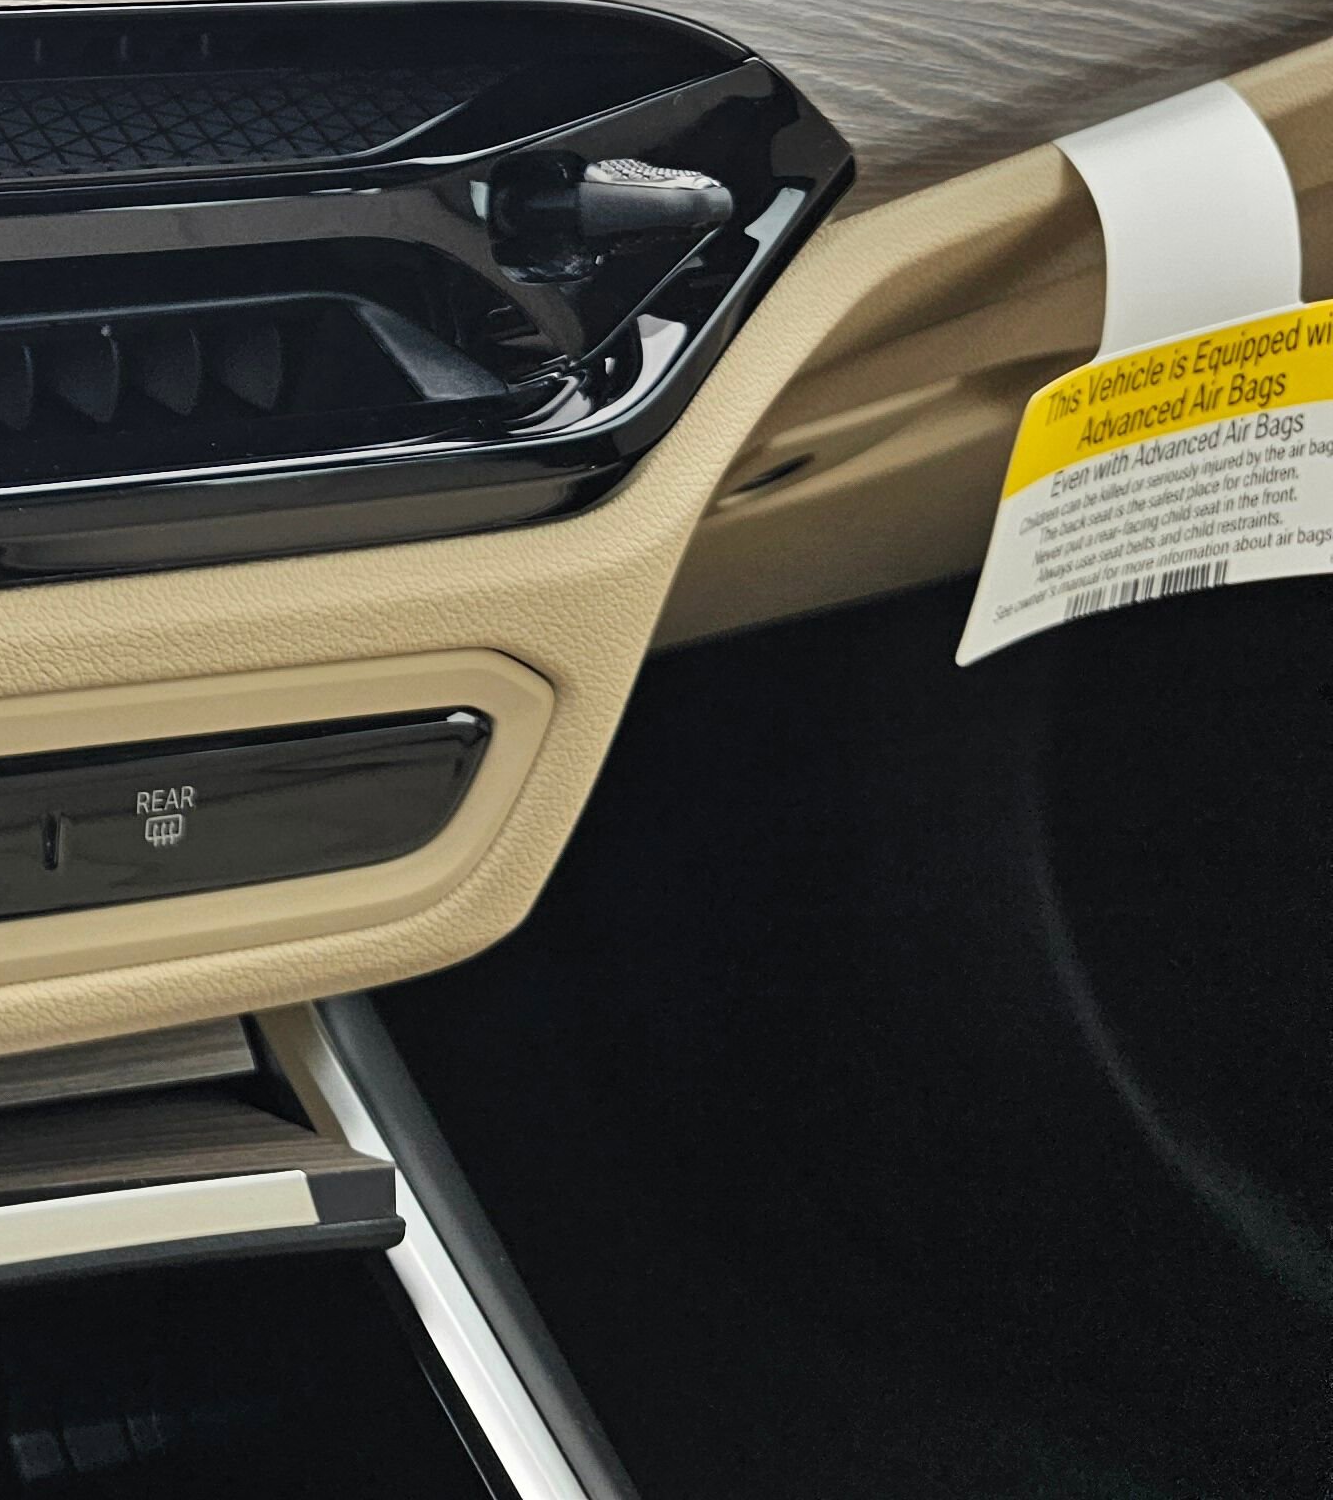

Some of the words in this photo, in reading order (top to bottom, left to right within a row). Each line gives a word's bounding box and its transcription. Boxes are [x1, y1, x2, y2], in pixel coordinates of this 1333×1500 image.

[1045, 383, 1082, 426] This
[1088, 356, 1165, 405] Vehicle
[1168, 348, 1188, 380] is
[1192, 318, 1302, 375] Equipped
[1076, 388, 1189, 450] Advanced
[1189, 379, 1224, 416] Air
[1227, 372, 1287, 408] Bags
[1050, 467, 1090, 498] Even
[1092, 448, 1129, 482] with
[1131, 422, 1222, 469] Advanced
[1222, 417, 1251, 447] Air
[1253, 411, 1305, 441] Bags
[1147, 462, 1199, 488] seriously
[1201, 450, 1244, 474] injured
[1246, 448, 1262, 467] by
[1264, 443, 1285, 462] the
[1287, 439, 1306, 458] air
[1185, 479, 1220, 503] place
[1222, 475, 1240, 492] for
[1242, 465, 1299, 487] children.
[1161, 504, 1191, 526] child
[1193, 501, 1220, 518] seat
[1222, 498, 1235, 513] in
[1237, 493, 1259, 509] the
[1261, 487, 1298, 505] front.
[1156, 540, 1230, 568] information
[1233, 531, 1272, 552] about
[1275, 528, 1295, 545] air
[1157, 526, 1182, 546] and
[1183, 519, 1215, 539] child
[136, 785, 197, 815] REAR
